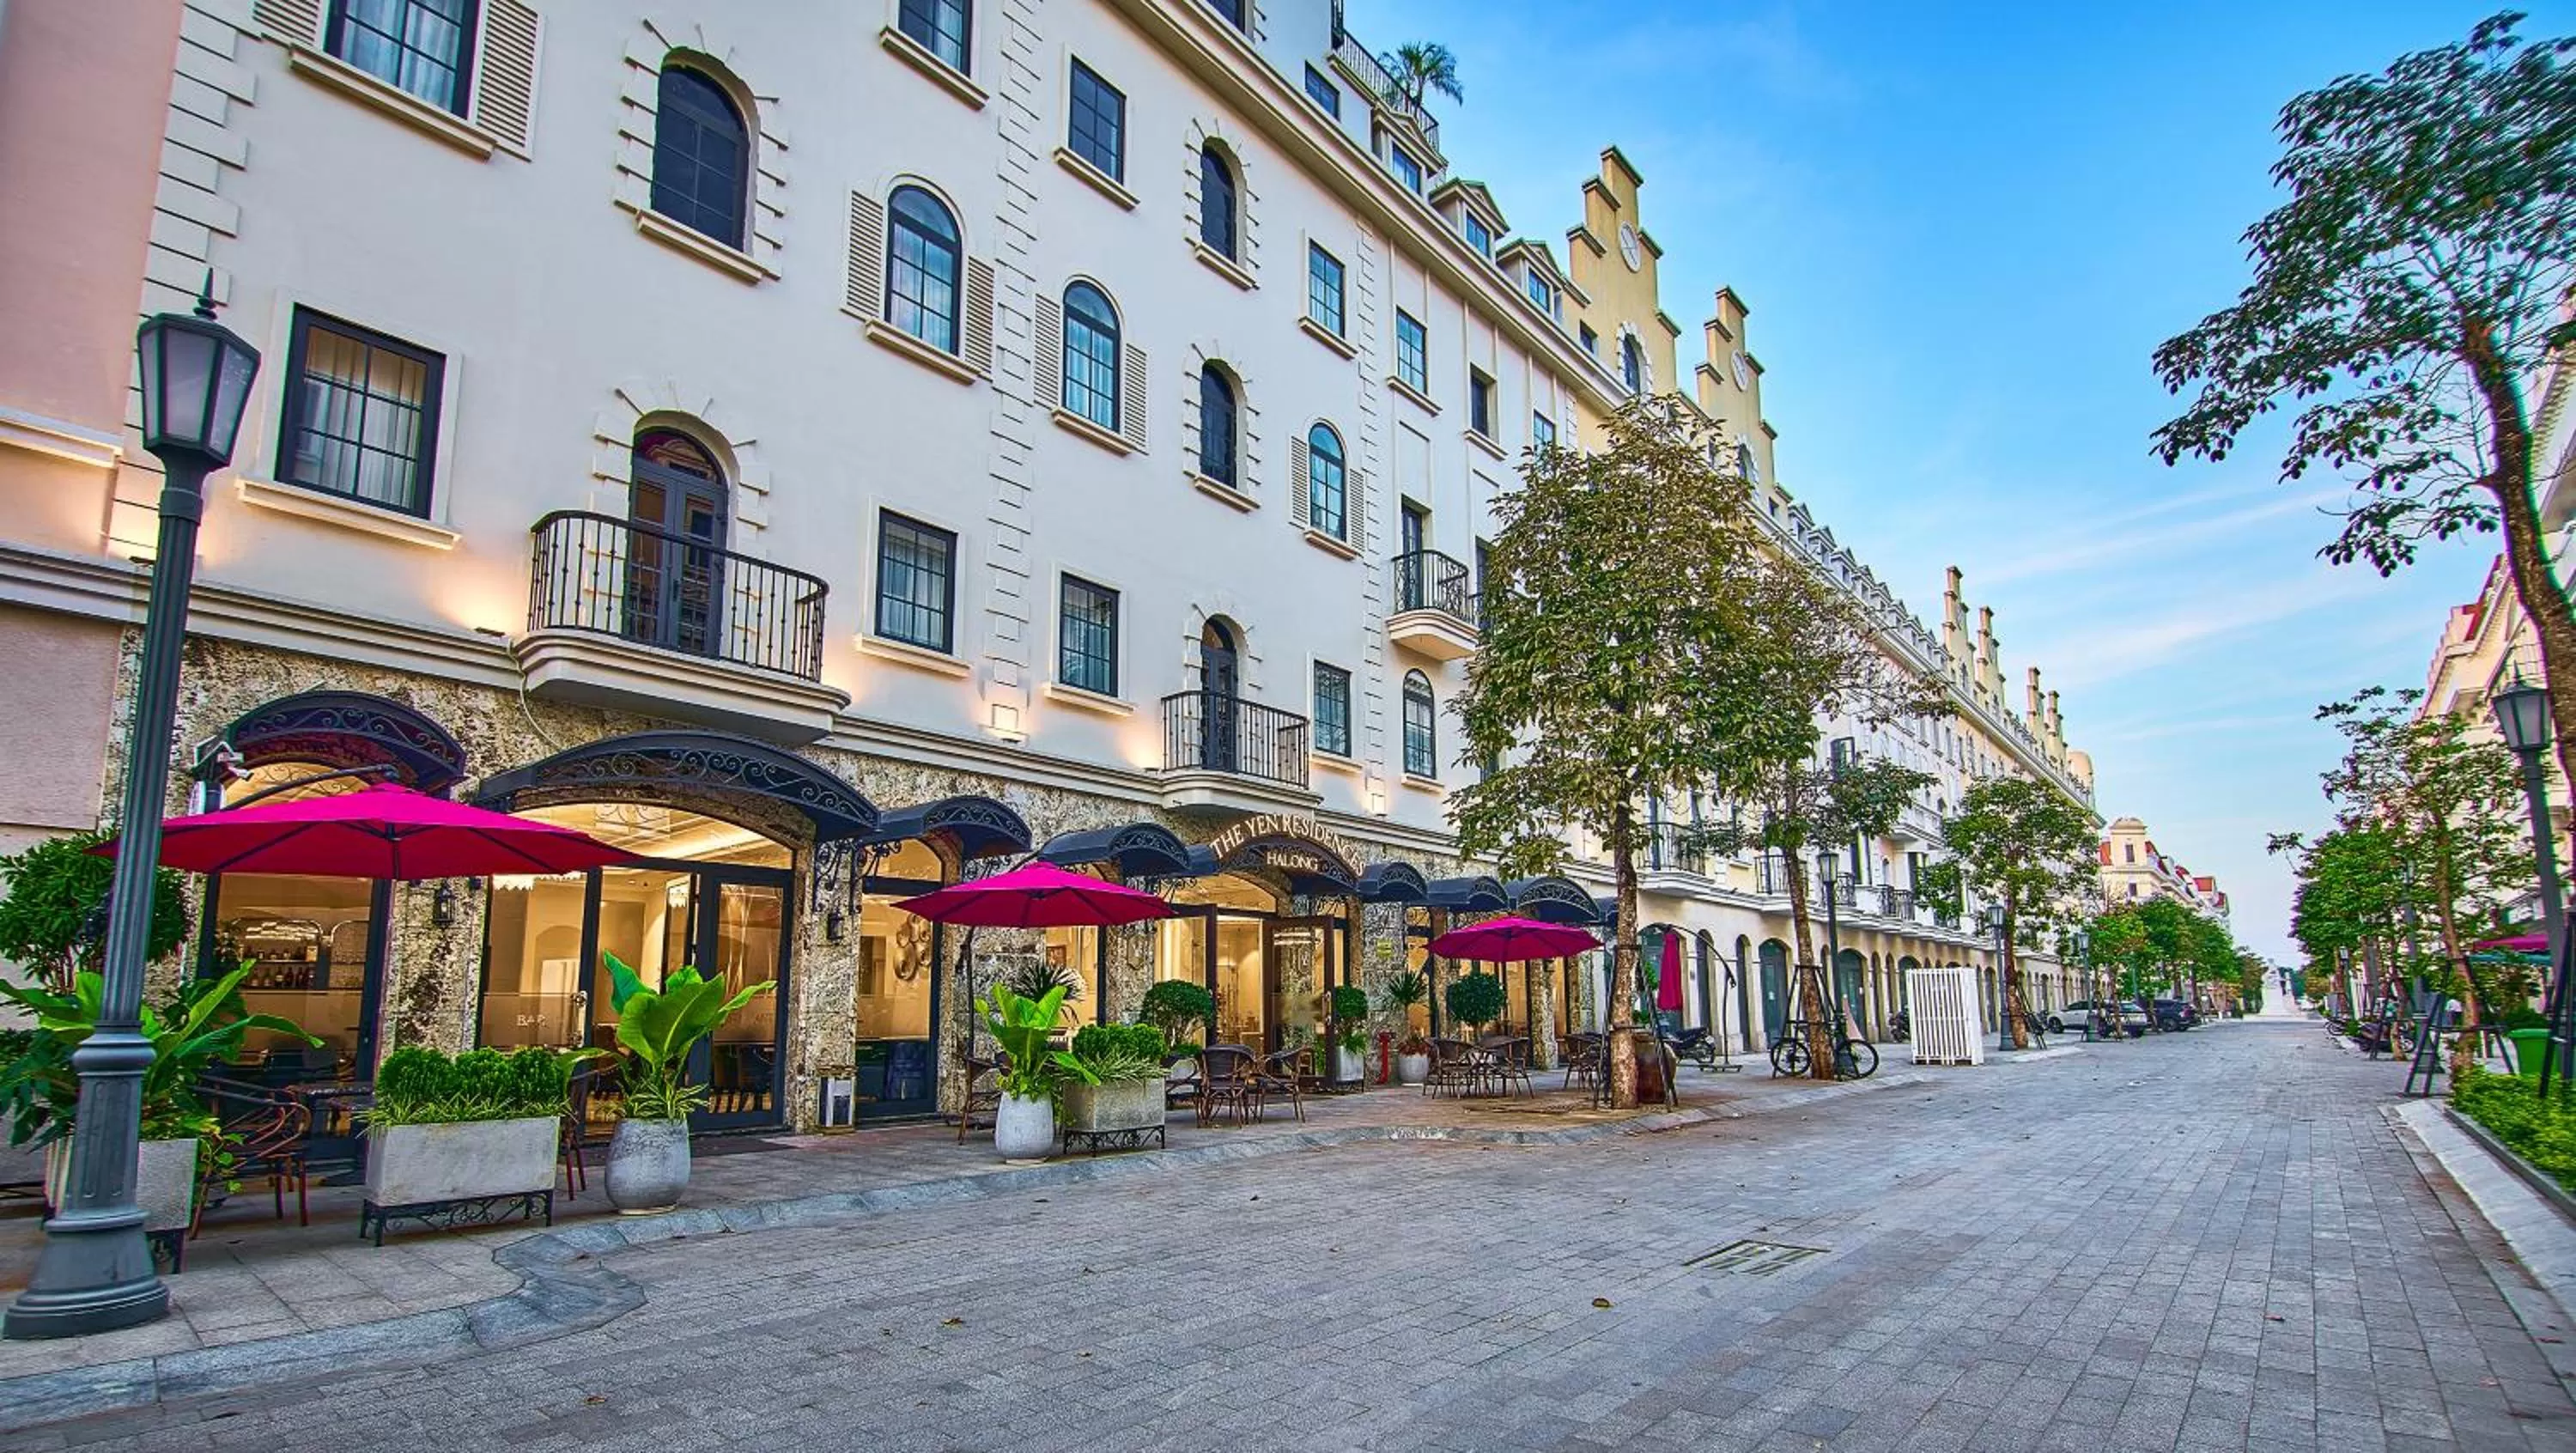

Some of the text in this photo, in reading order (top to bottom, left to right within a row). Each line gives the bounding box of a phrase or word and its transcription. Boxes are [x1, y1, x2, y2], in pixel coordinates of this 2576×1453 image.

[1209, 814, 1366, 876] THE YEN RESIDENCES
[1267, 852, 1318, 870] HALONG
[516, 1014, 547, 1026] BAR
